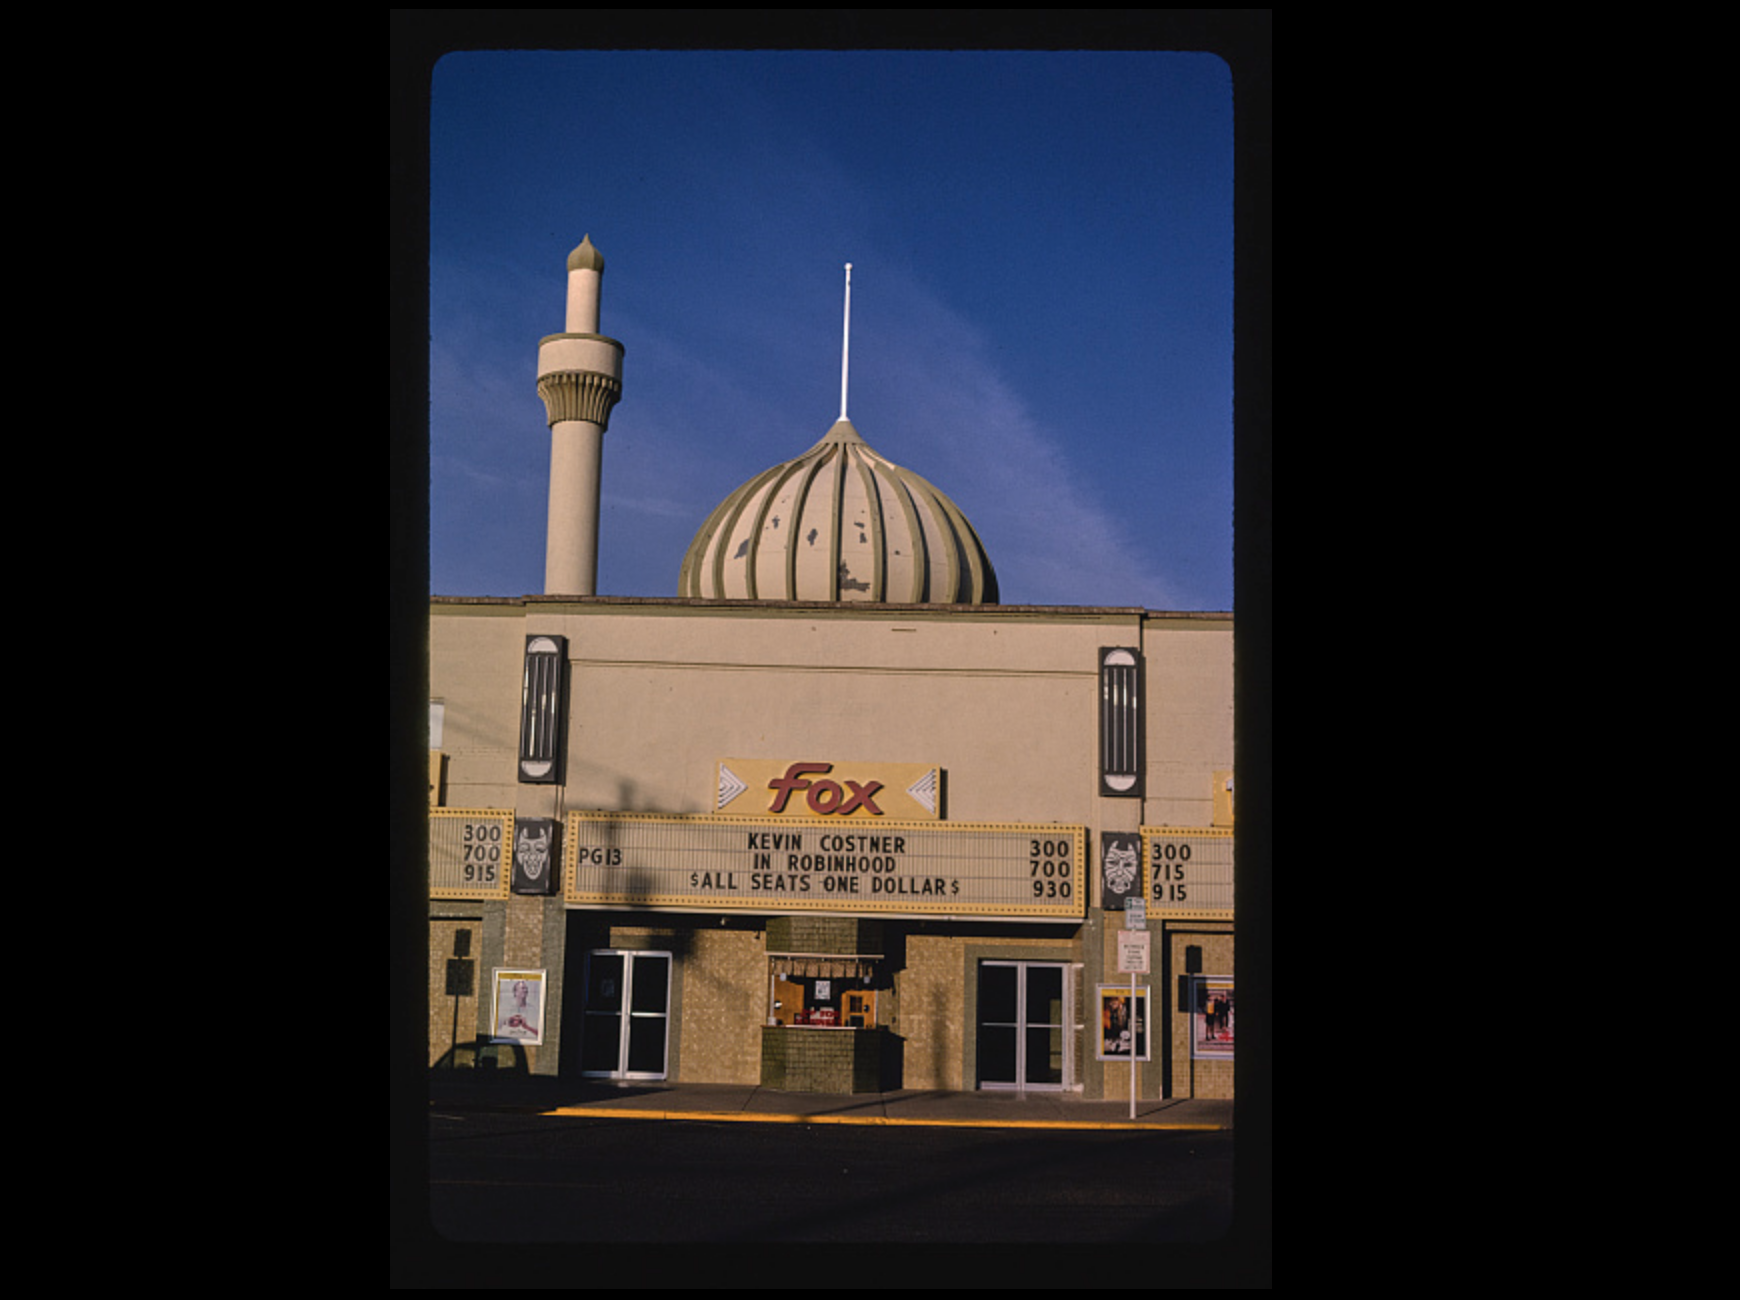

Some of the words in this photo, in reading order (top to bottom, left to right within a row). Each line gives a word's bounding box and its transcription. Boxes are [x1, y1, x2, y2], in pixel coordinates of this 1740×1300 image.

[463, 824, 501, 842] 300
[747, 832, 802, 851] KEVIN
[819, 834, 906, 854] COSTNER
[1030, 839, 1069, 858] 300
[1152, 843, 1191, 861] 300
[463, 844, 501, 862] 700
[579, 847, 622, 866] PG13
[753, 853, 774, 871] IN
[787, 854, 896, 874] ROBINHOOD
[1029, 860, 1071, 878] 700
[1151, 863, 1185, 881] 715
[464, 864, 496, 882] 915
[751, 873, 811, 892] SEATS
[823, 875, 859, 894] ONE
[1033, 880, 1071, 898] 930
[1152, 883, 1187, 902] 915
